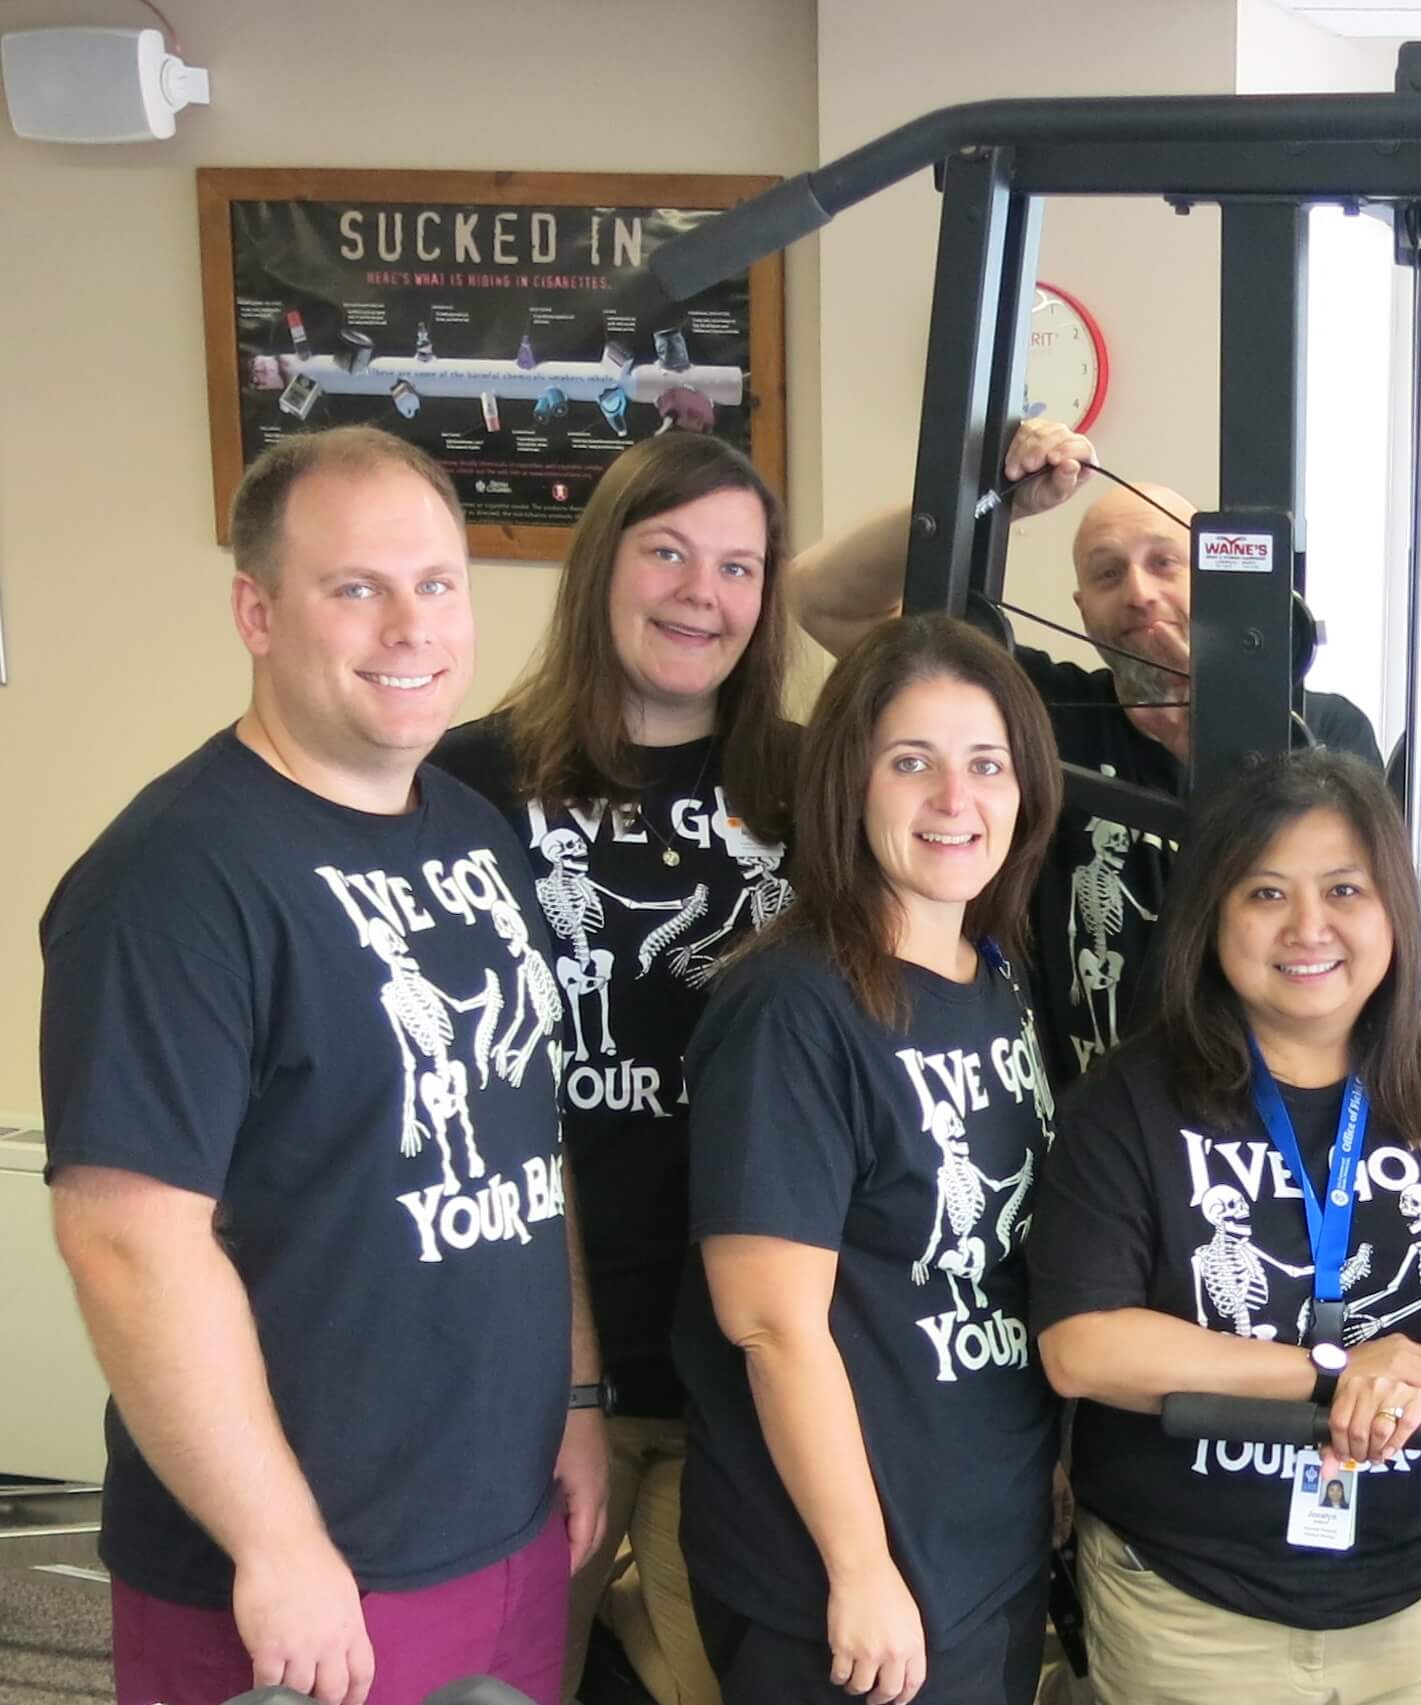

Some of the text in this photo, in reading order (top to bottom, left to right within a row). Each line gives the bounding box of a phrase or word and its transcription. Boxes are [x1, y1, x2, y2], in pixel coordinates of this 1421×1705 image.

[339, 210, 643, 268] SUCKED IN
[366, 272, 410, 286] HERE'S
[415, 272, 444, 286] WHAT
[450, 272, 464, 286] IS
[468, 273, 511, 288] HIDING
[516, 274, 529, 288] IN
[1030, 332, 1056, 347] RIT
[1072, 327, 1080, 340] 2
[1081, 362, 1088, 376] 3
[1204, 536, 1268, 556] WAYNE'S
[526, 797, 648, 849] IVE
[314, 848, 521, 948] I'VE GOT
[562, 1050, 672, 1118] OUR
[895, 1048, 990, 1133] I'VE
[991, 1036, 1036, 1105] GO
[1179, 1128, 1304, 1207] I'VE
[396, 1153, 566, 1263] YOUR BA
[914, 1309, 1030, 1382] YOUR
